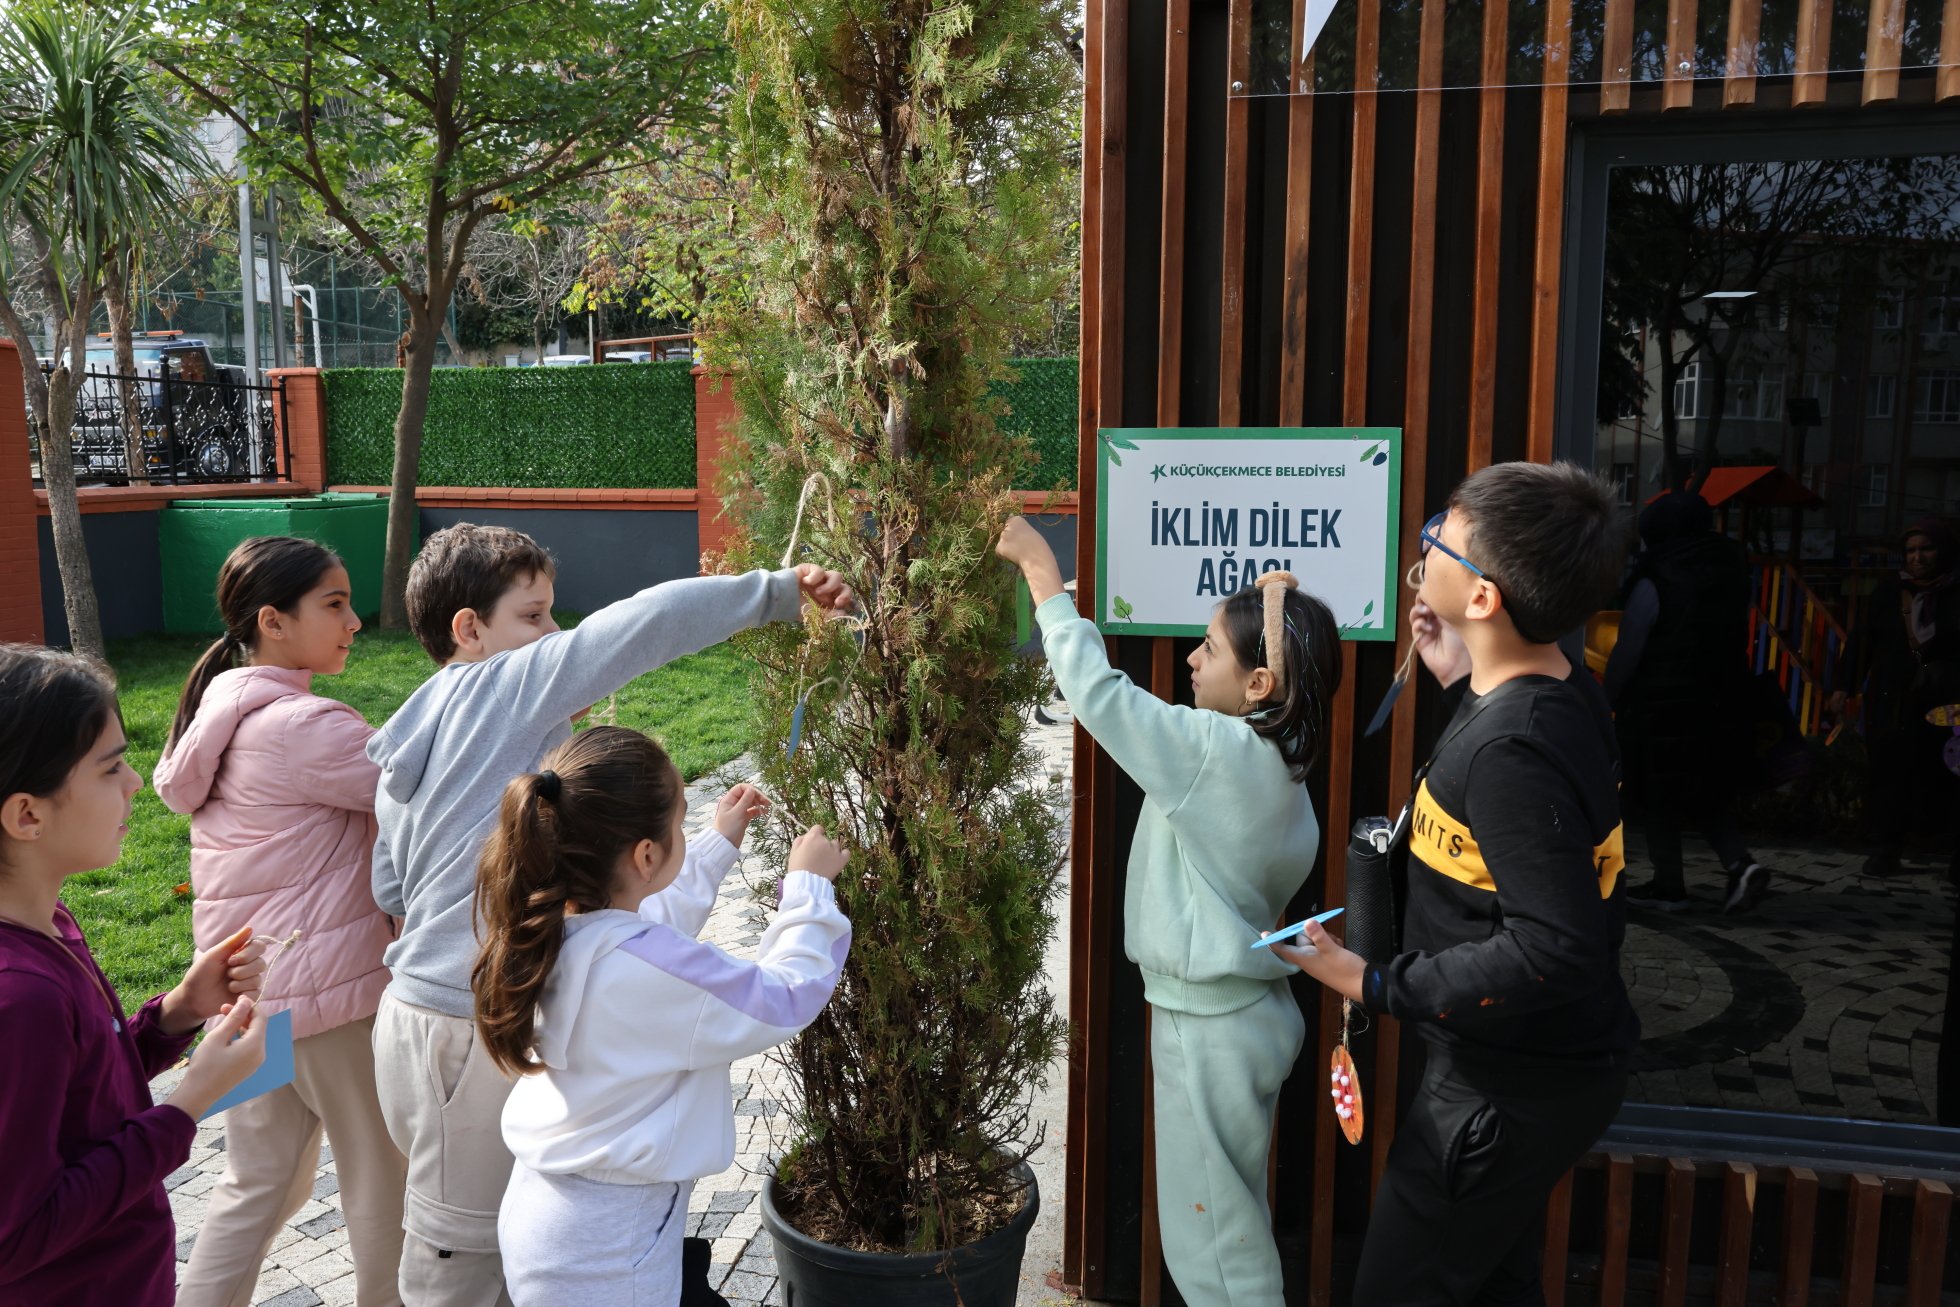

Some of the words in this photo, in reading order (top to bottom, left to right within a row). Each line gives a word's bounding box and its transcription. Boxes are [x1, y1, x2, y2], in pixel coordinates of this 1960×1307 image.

[1170, 463, 1272, 478] KÜÇÜKÇEKMECE
[1275, 463, 1346, 477] BELEDİYESİ
[1151, 500, 1239, 547] İKLİM
[1249, 501, 1343, 548] DİLEK
